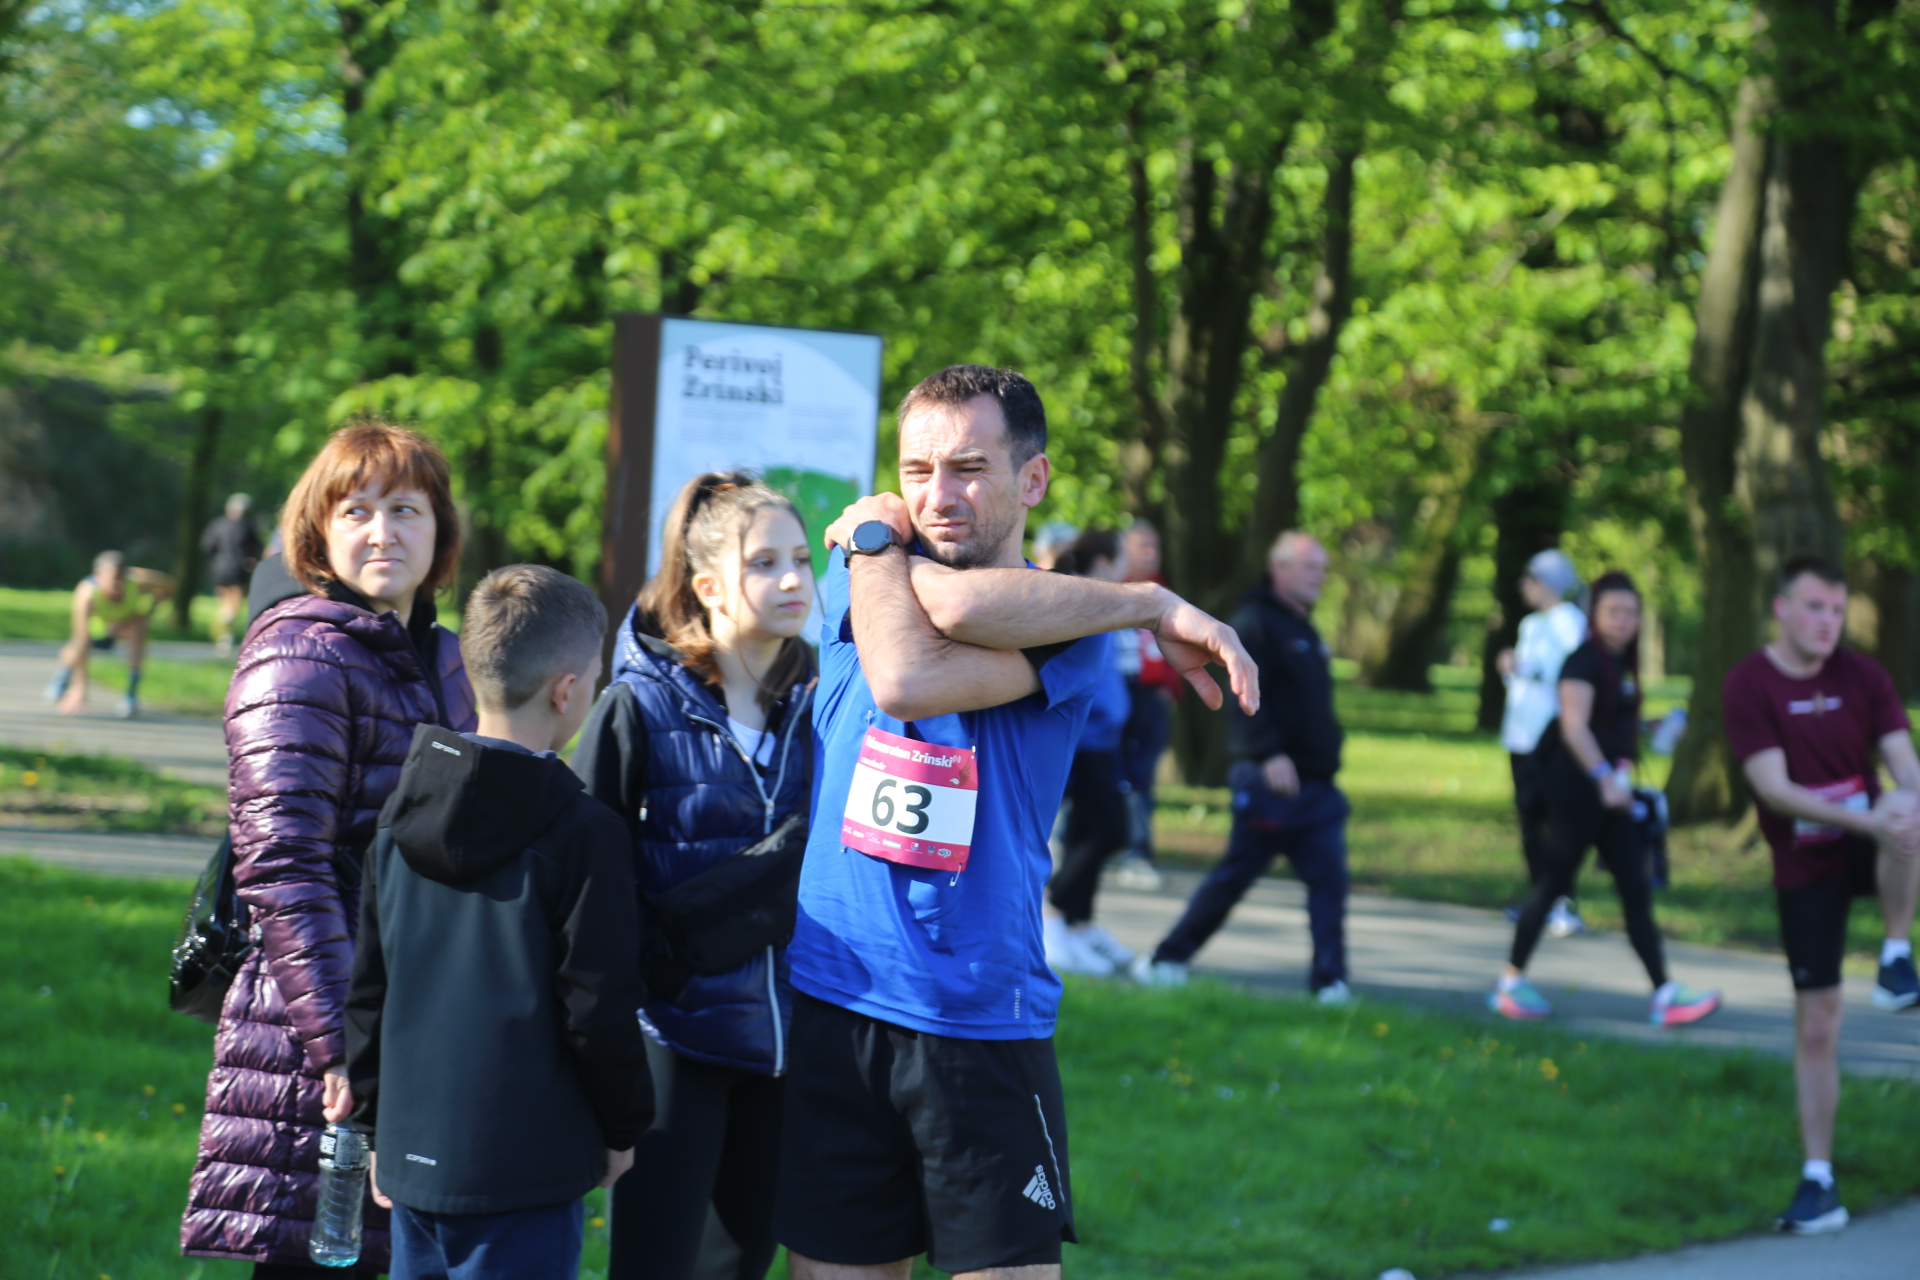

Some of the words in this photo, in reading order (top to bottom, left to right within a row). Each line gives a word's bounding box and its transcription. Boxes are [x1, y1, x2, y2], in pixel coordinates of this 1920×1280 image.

[682, 375, 783, 404] Zrinski
[872, 779, 932, 835] 63
[1035, 1165, 1056, 1210] adidas
